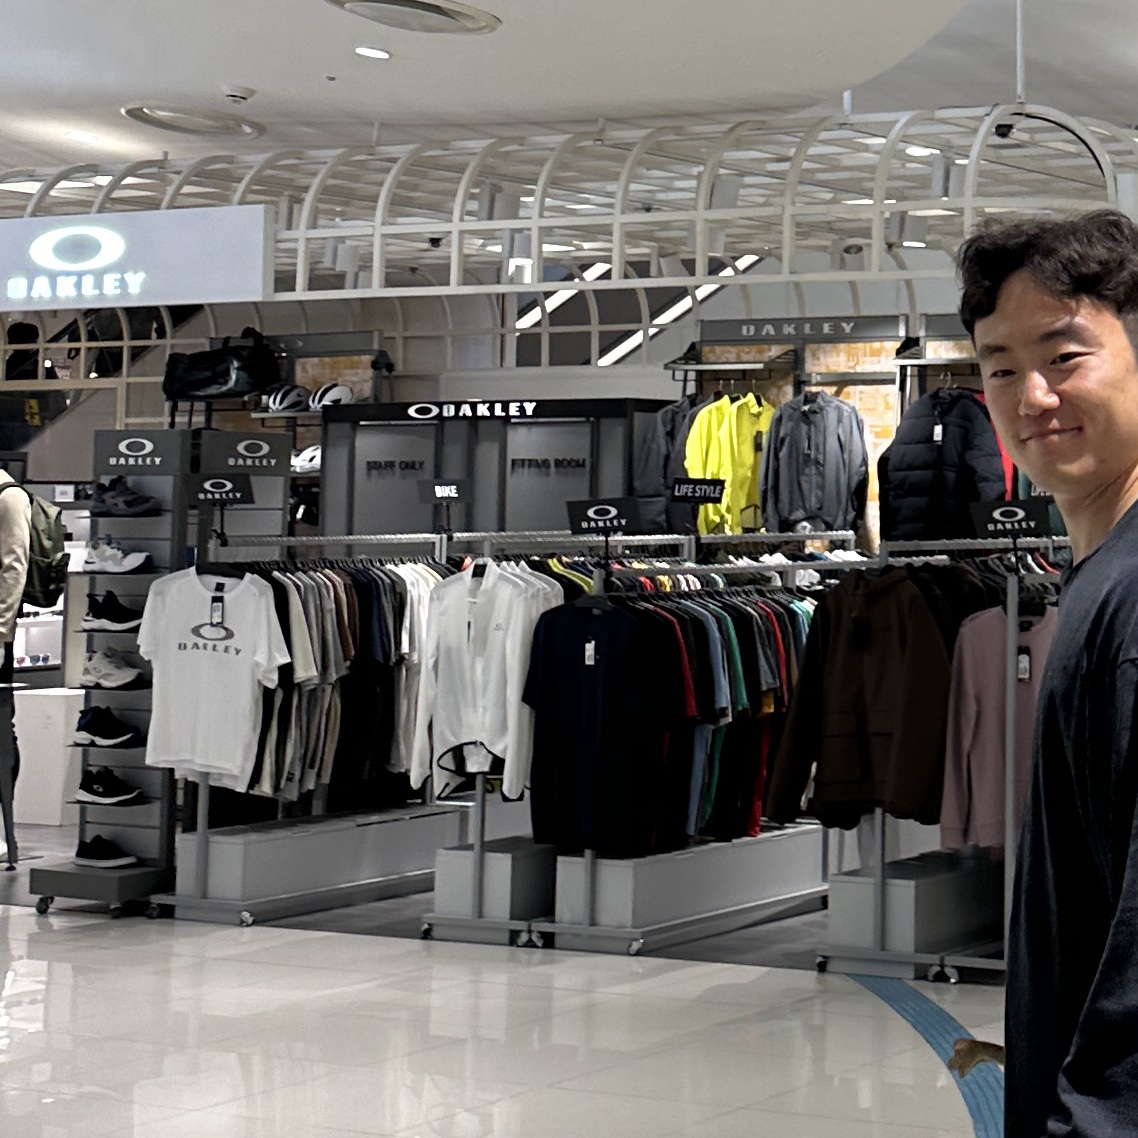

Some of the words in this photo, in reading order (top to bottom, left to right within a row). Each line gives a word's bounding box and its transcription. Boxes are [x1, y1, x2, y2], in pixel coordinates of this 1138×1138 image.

[6, 271, 146, 300] OAKLEY
[741, 322, 854, 336] OAKLEY
[442, 401, 537, 418] OAKLEY
[109, 456, 162, 466] OAKLEY
[227, 457, 277, 467] OAKLEY
[198, 492, 242, 500] OAKLEY
[434, 485, 459, 498] BIKE
[674, 484, 694, 496] LIFE
[695, 484, 722, 498] STYLE
[581, 518, 627, 529] OAKLEY
[987, 521, 1036, 531] OAKLEY
